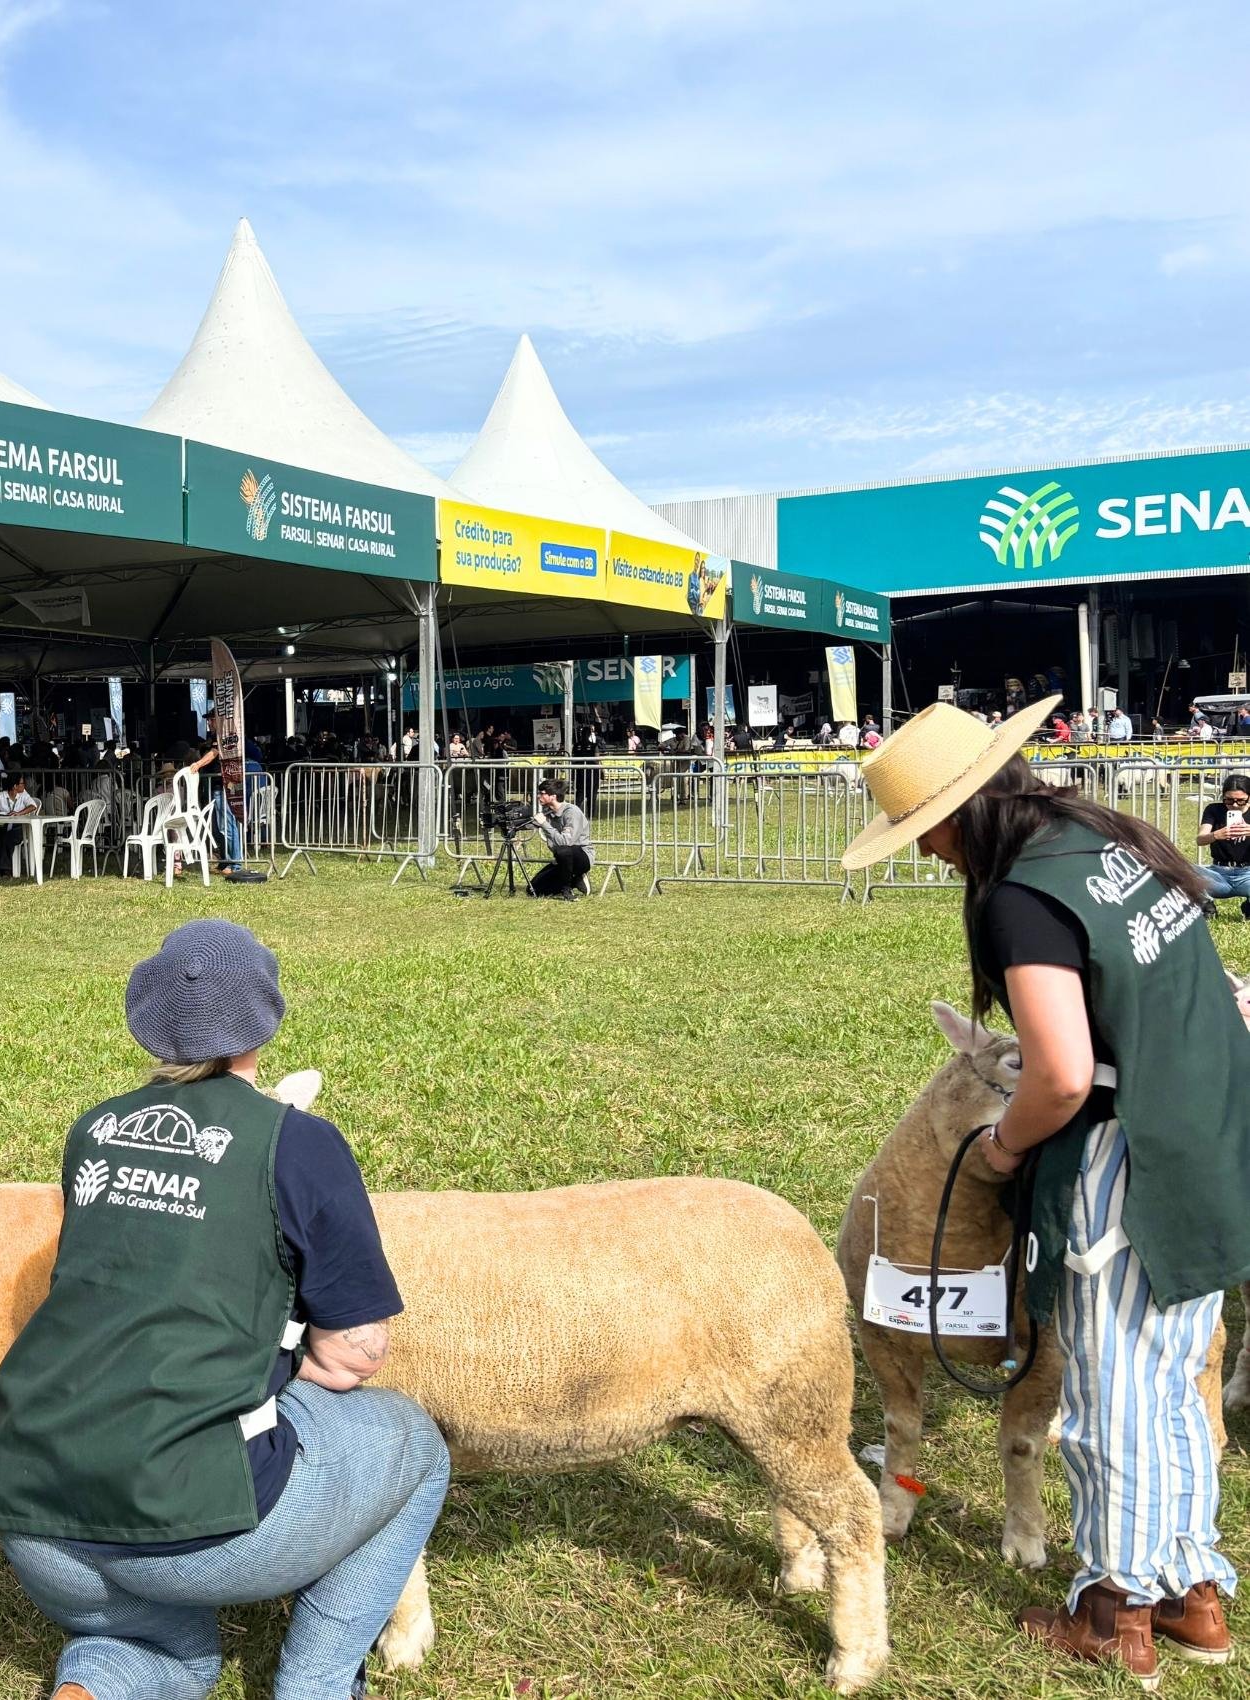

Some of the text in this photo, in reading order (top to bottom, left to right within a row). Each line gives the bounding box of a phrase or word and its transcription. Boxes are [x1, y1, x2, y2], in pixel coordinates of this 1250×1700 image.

[48, 448, 124, 486] FARSUL
[4, 481, 47, 504] SENAR
[53, 488, 85, 509] CASA
[87, 493, 125, 514] RURAL
[281, 491, 396, 536] SISTEMA FARSUL
[281, 525, 396, 558] FARSUL SENAR CASA RURAL
[455, 519, 513, 547] Crédito para
[456, 552, 522, 576] sua produção?
[544, 550, 594, 570] Simule com o BB
[613, 558, 683, 587] Visite o estande do BB
[587, 656, 677, 682] SENR
[409, 676, 514, 692] mmenta o Agro.
[112, 1166, 201, 1202] SENAR
[107, 1191, 206, 1220] Rio Grande do Sul
[901, 1285, 968, 1310] 477
